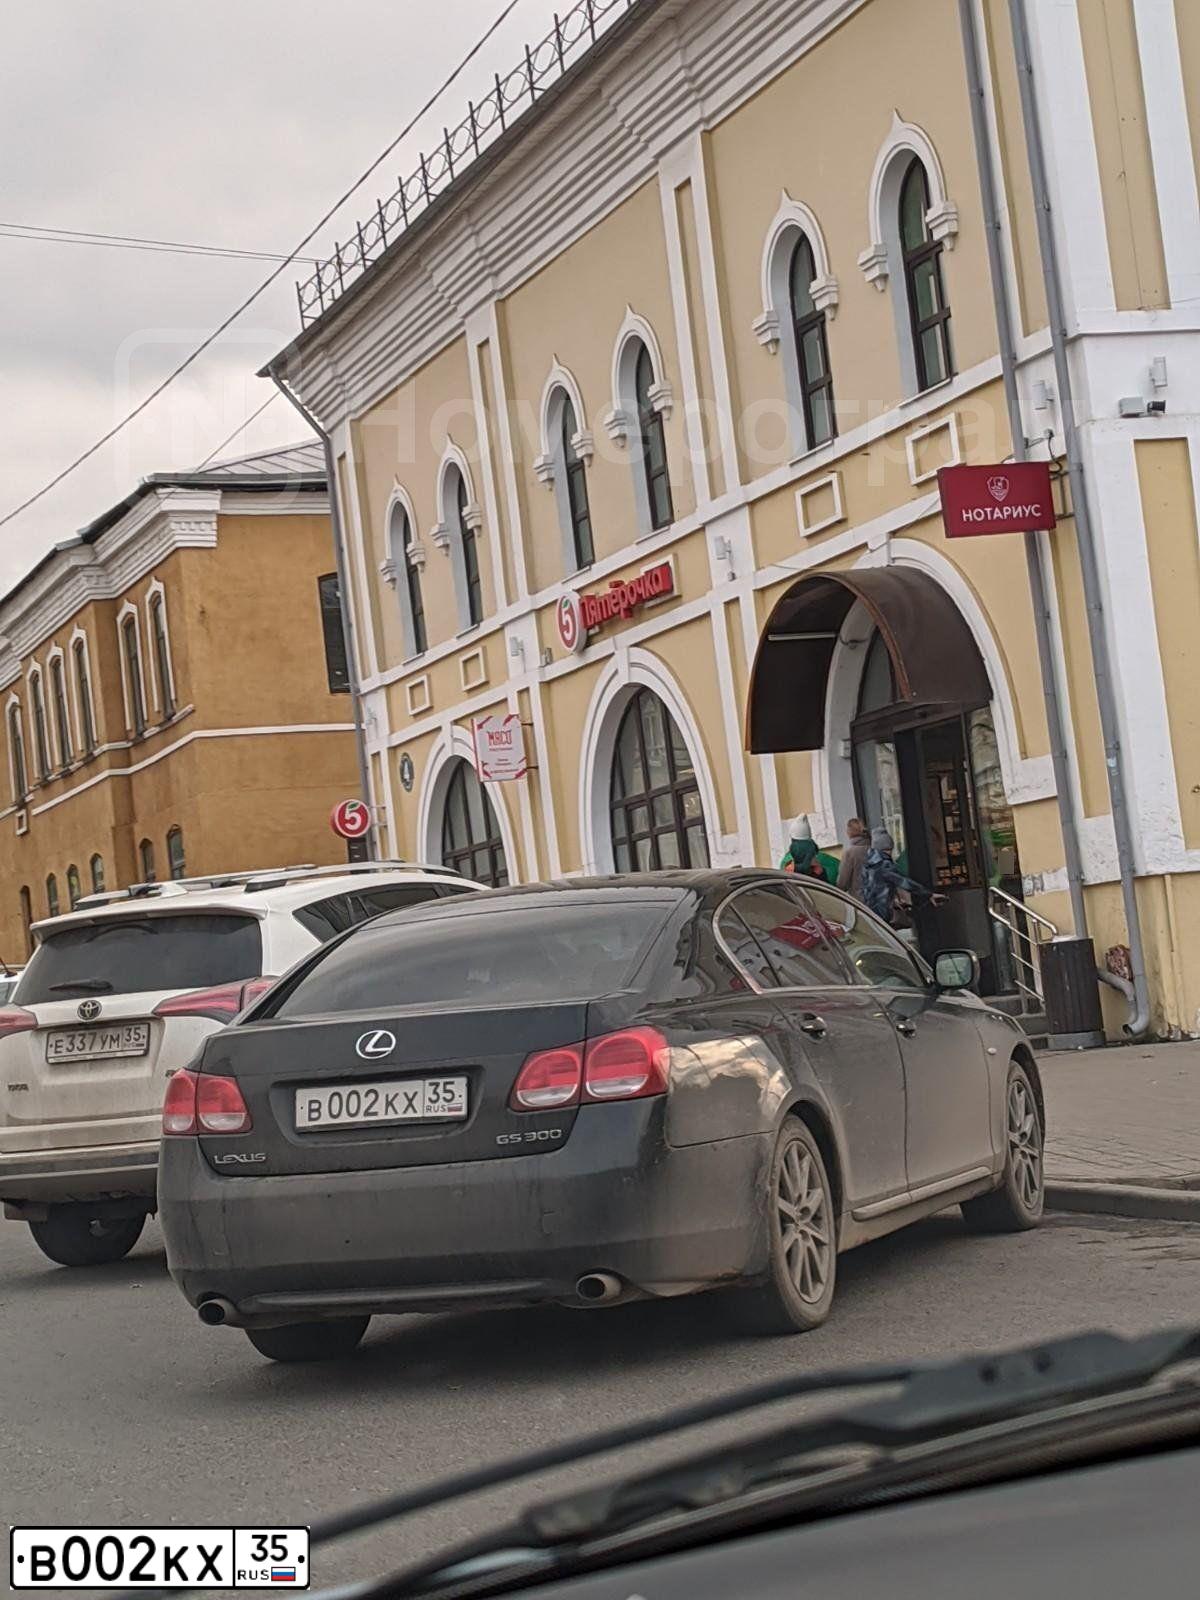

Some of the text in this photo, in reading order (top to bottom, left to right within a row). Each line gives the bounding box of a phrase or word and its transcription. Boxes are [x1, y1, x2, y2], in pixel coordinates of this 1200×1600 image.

[962, 504, 1042, 522] НОТАРИУС
[344, 801, 362, 830] 5
[307, 1081, 455, 1121] В002КХ 35
[426, 1104, 446, 1113] RUS
[496, 1129, 562, 1145] GS 300
[214, 1153, 266, 1164] LEXUS
